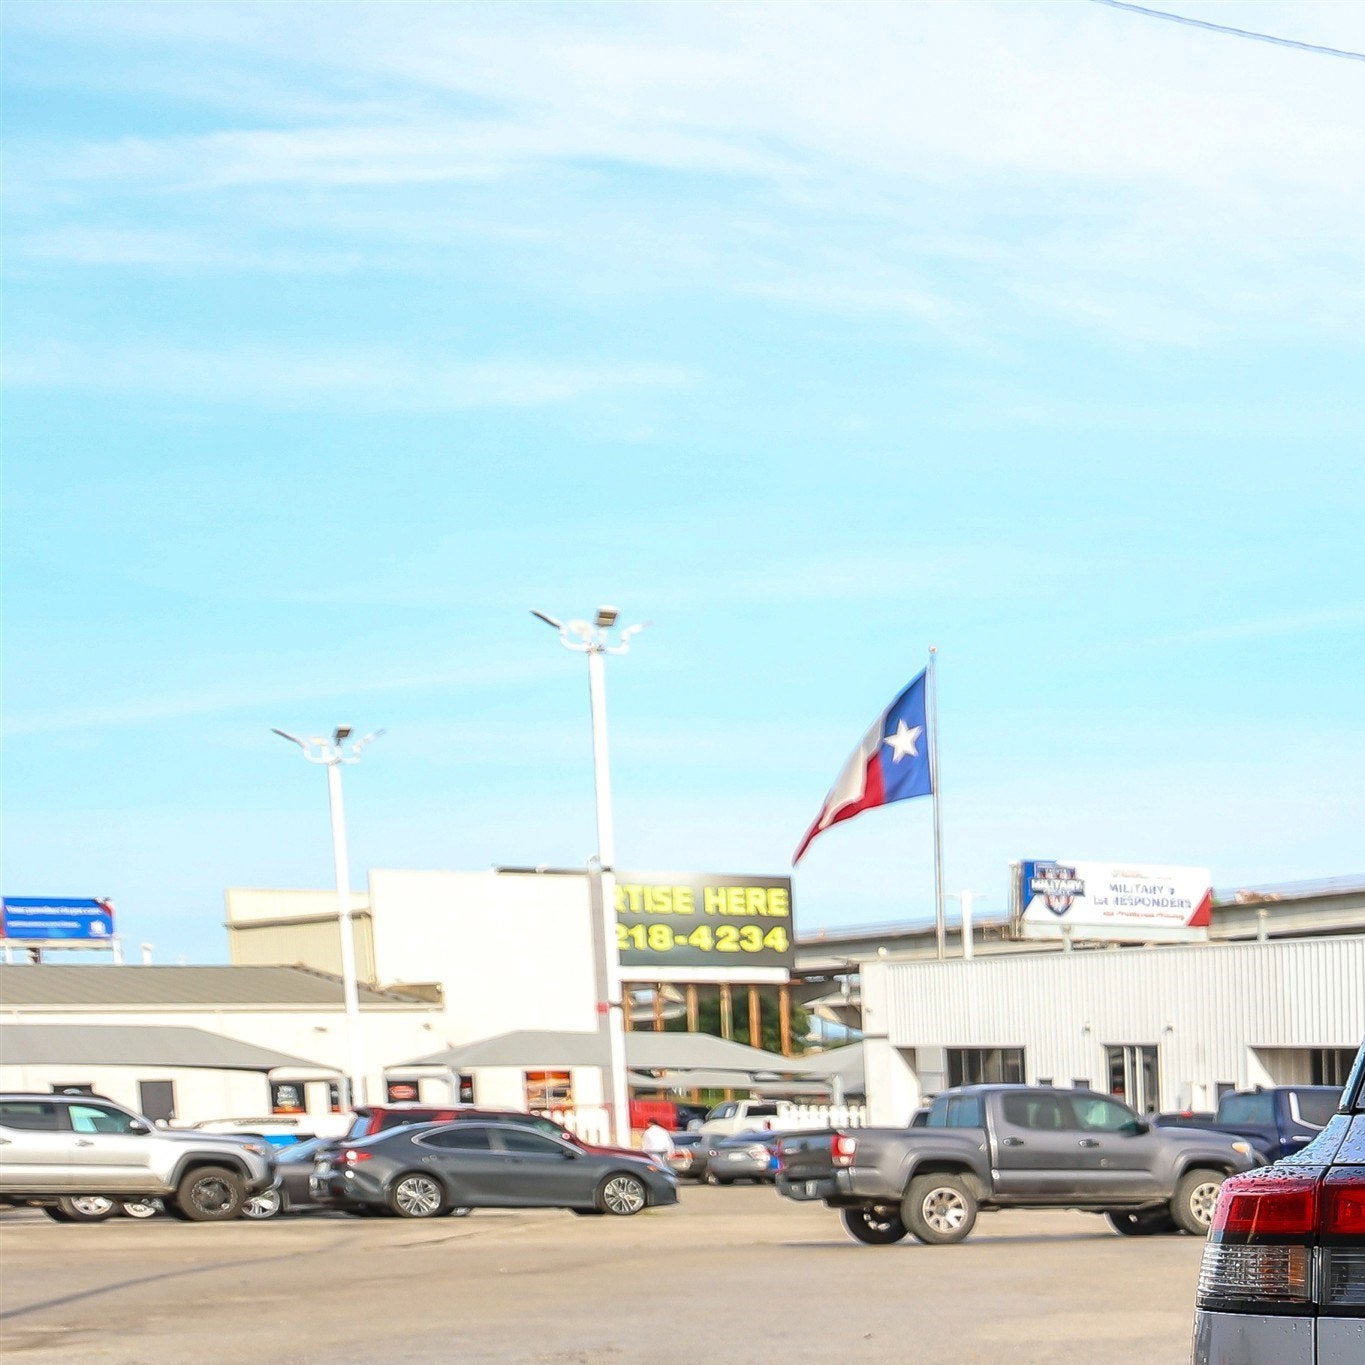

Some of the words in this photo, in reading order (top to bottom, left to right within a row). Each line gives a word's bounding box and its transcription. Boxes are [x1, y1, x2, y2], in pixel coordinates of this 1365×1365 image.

[704, 887, 789, 917] HERE
[1109, 883, 1164, 895] MILITARY
[615, 923, 789, 953] 218-4234
